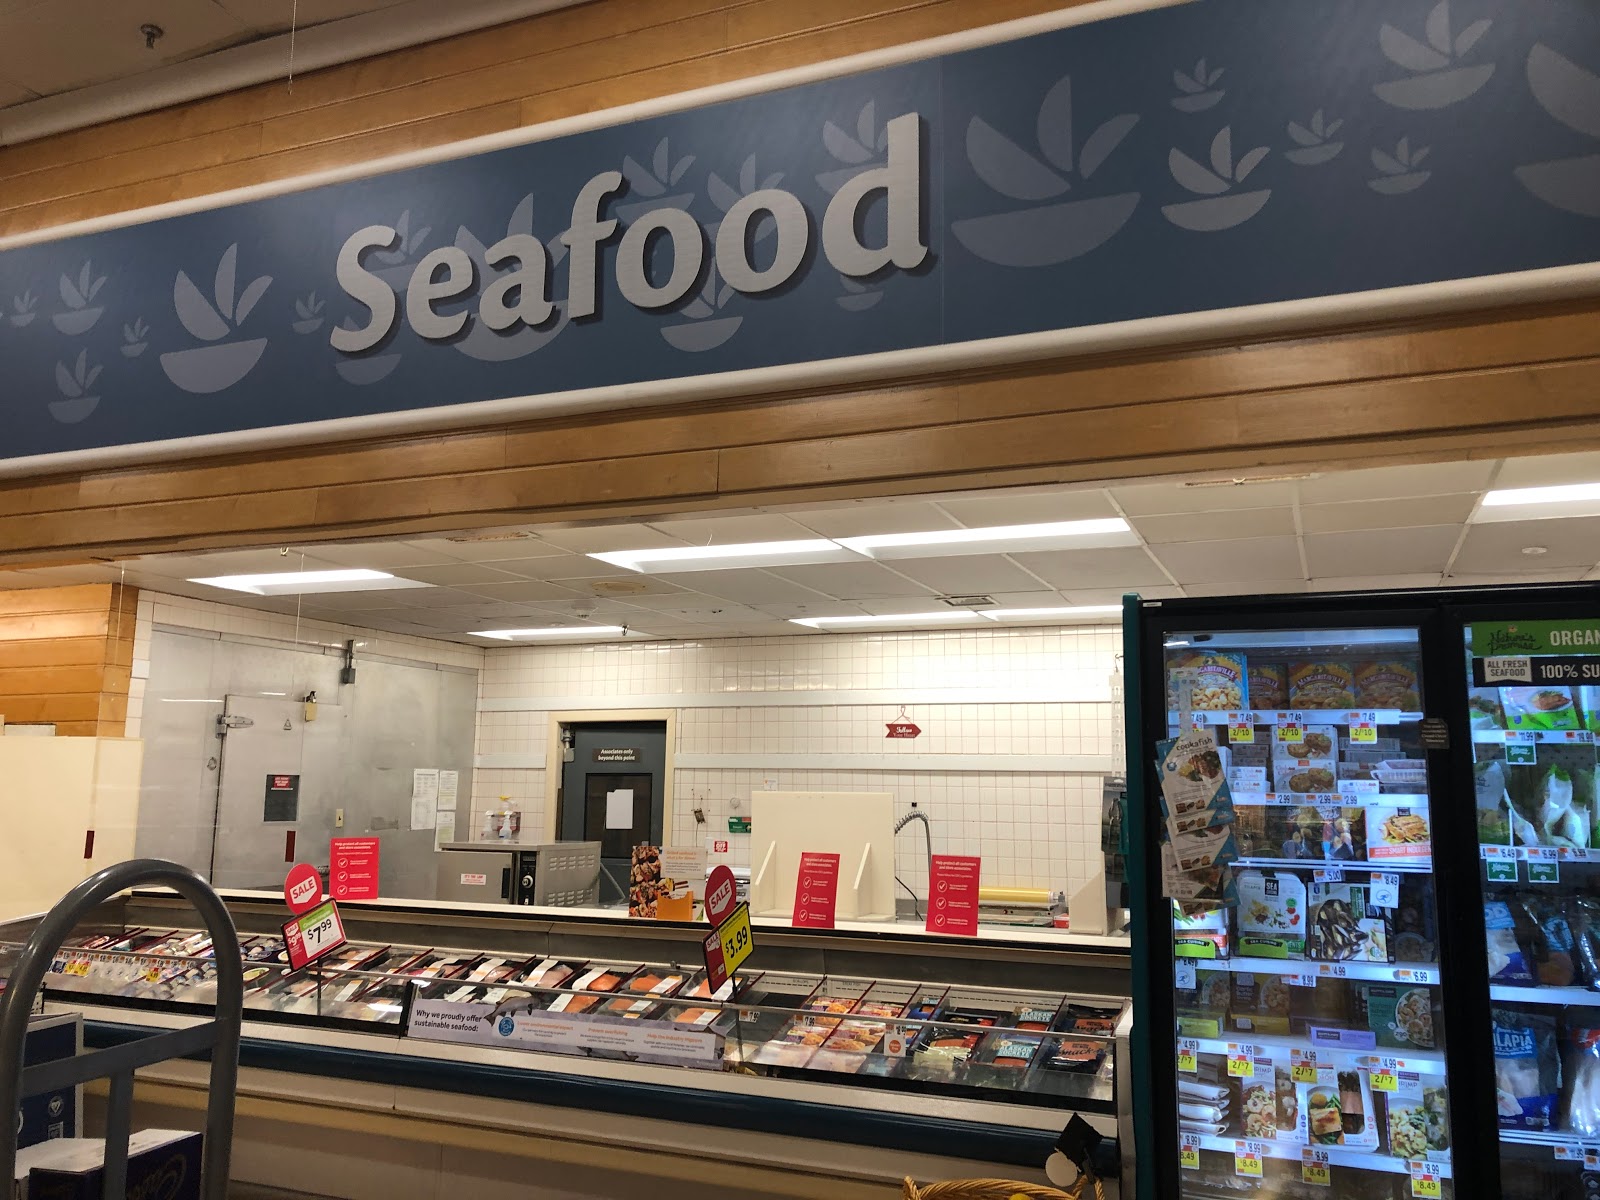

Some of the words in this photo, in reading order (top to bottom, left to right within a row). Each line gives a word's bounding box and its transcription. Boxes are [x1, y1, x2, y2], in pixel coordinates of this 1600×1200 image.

[329, 111, 929, 353] Seafood
[1487, 660, 1500, 669] ALL
[1502, 660, 1528, 668] FRESH
[1540, 664, 1579, 679] 100%
[1490, 669, 1526, 677] SEAFOOD
[623, 748, 634, 756] only
[292, 879, 315, 899] SALE
[1265, 881, 1278, 890] SEA
[710, 882, 731, 909] SALE
[286, 924, 298, 935] SALE
[706, 930, 719, 949] SALE
[416, 1009, 430, 1019] Why
[440, 1012, 465, 1022] proudly
[466, 1014, 482, 1023] offer
[414, 1019, 450, 1030] sustainable
[450, 1022, 479, 1032] seafood:
[1493, 1032, 1533, 1048] ILAPIA
